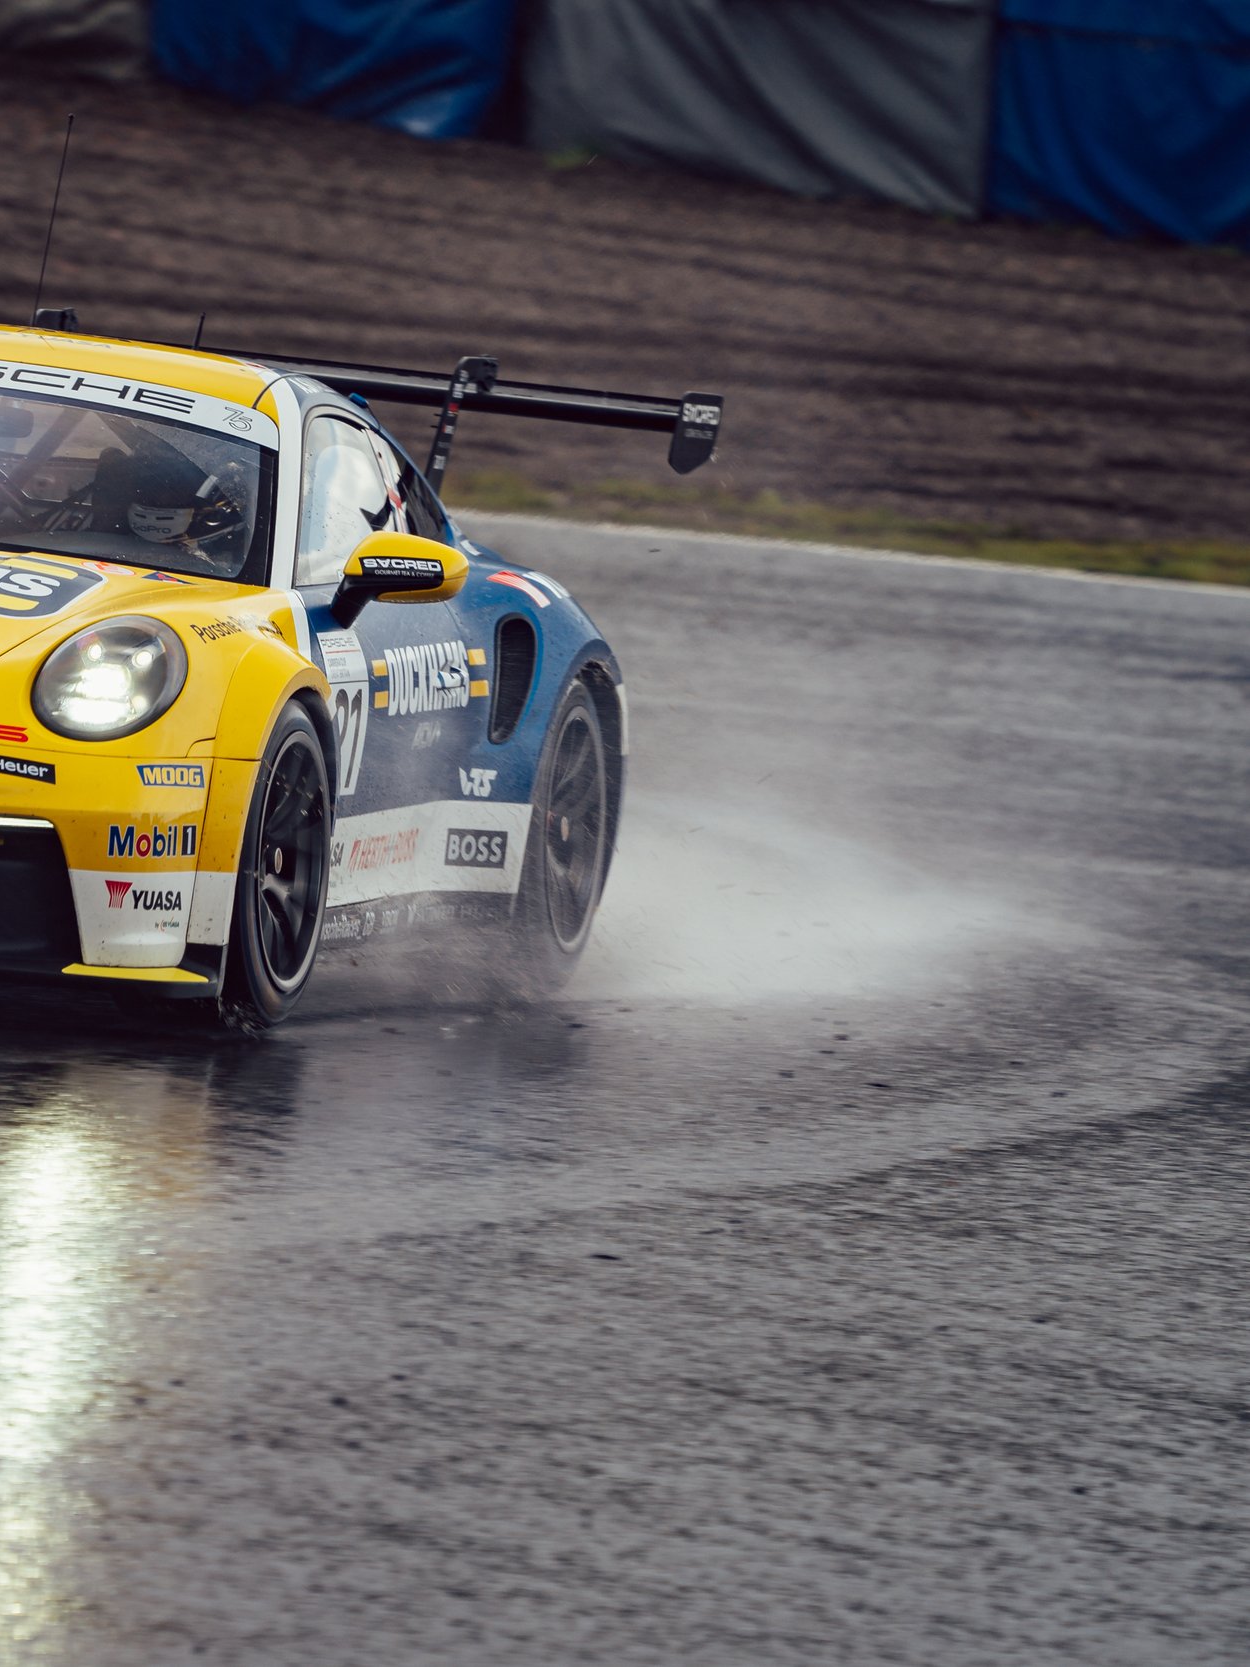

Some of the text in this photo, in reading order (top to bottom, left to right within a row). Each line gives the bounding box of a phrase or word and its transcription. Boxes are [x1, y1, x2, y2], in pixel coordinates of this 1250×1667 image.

[224, 406, 252, 432] 75
[362, 558, 442, 572] SACRED
[143, 766, 202, 786] MOOG
[107, 825, 178, 858] Mobil
[447, 834, 504, 865] BOSS
[132, 889, 182, 911] YUASA
